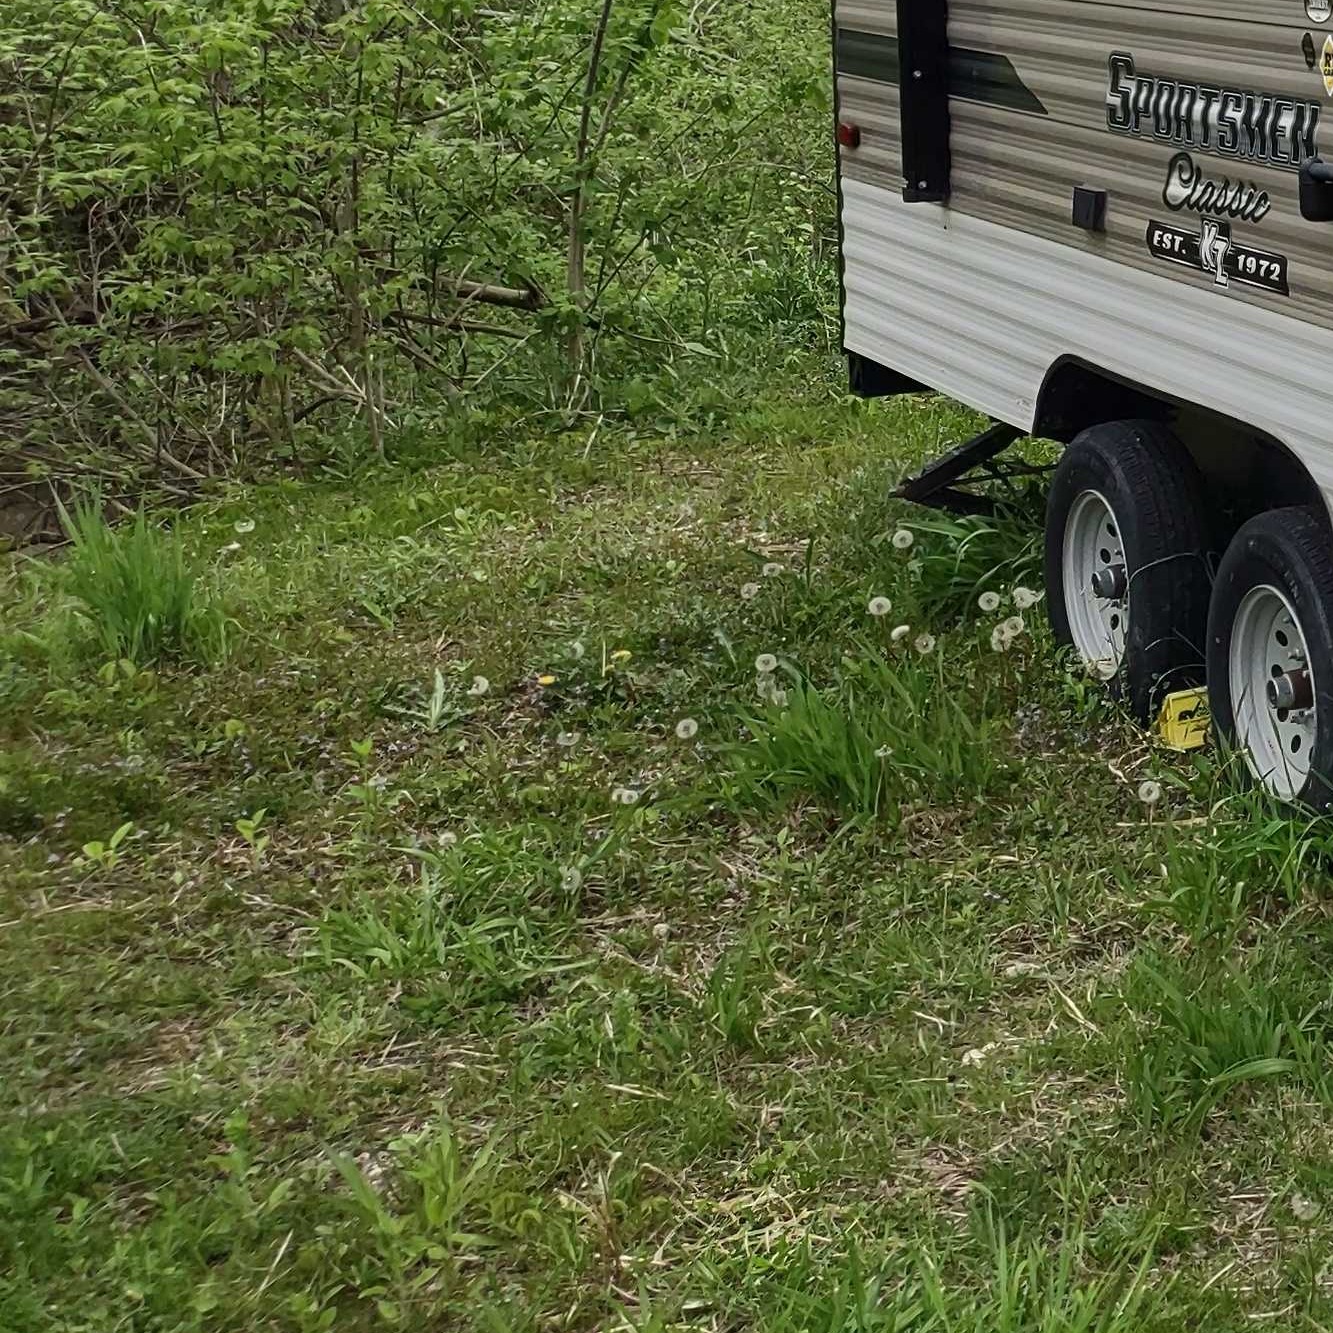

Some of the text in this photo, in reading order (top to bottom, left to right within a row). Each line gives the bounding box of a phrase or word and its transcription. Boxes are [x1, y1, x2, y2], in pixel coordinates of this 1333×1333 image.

[1162, 153, 1270, 223] Classic
[1152, 220, 1281, 288] EST. KZ 1972
